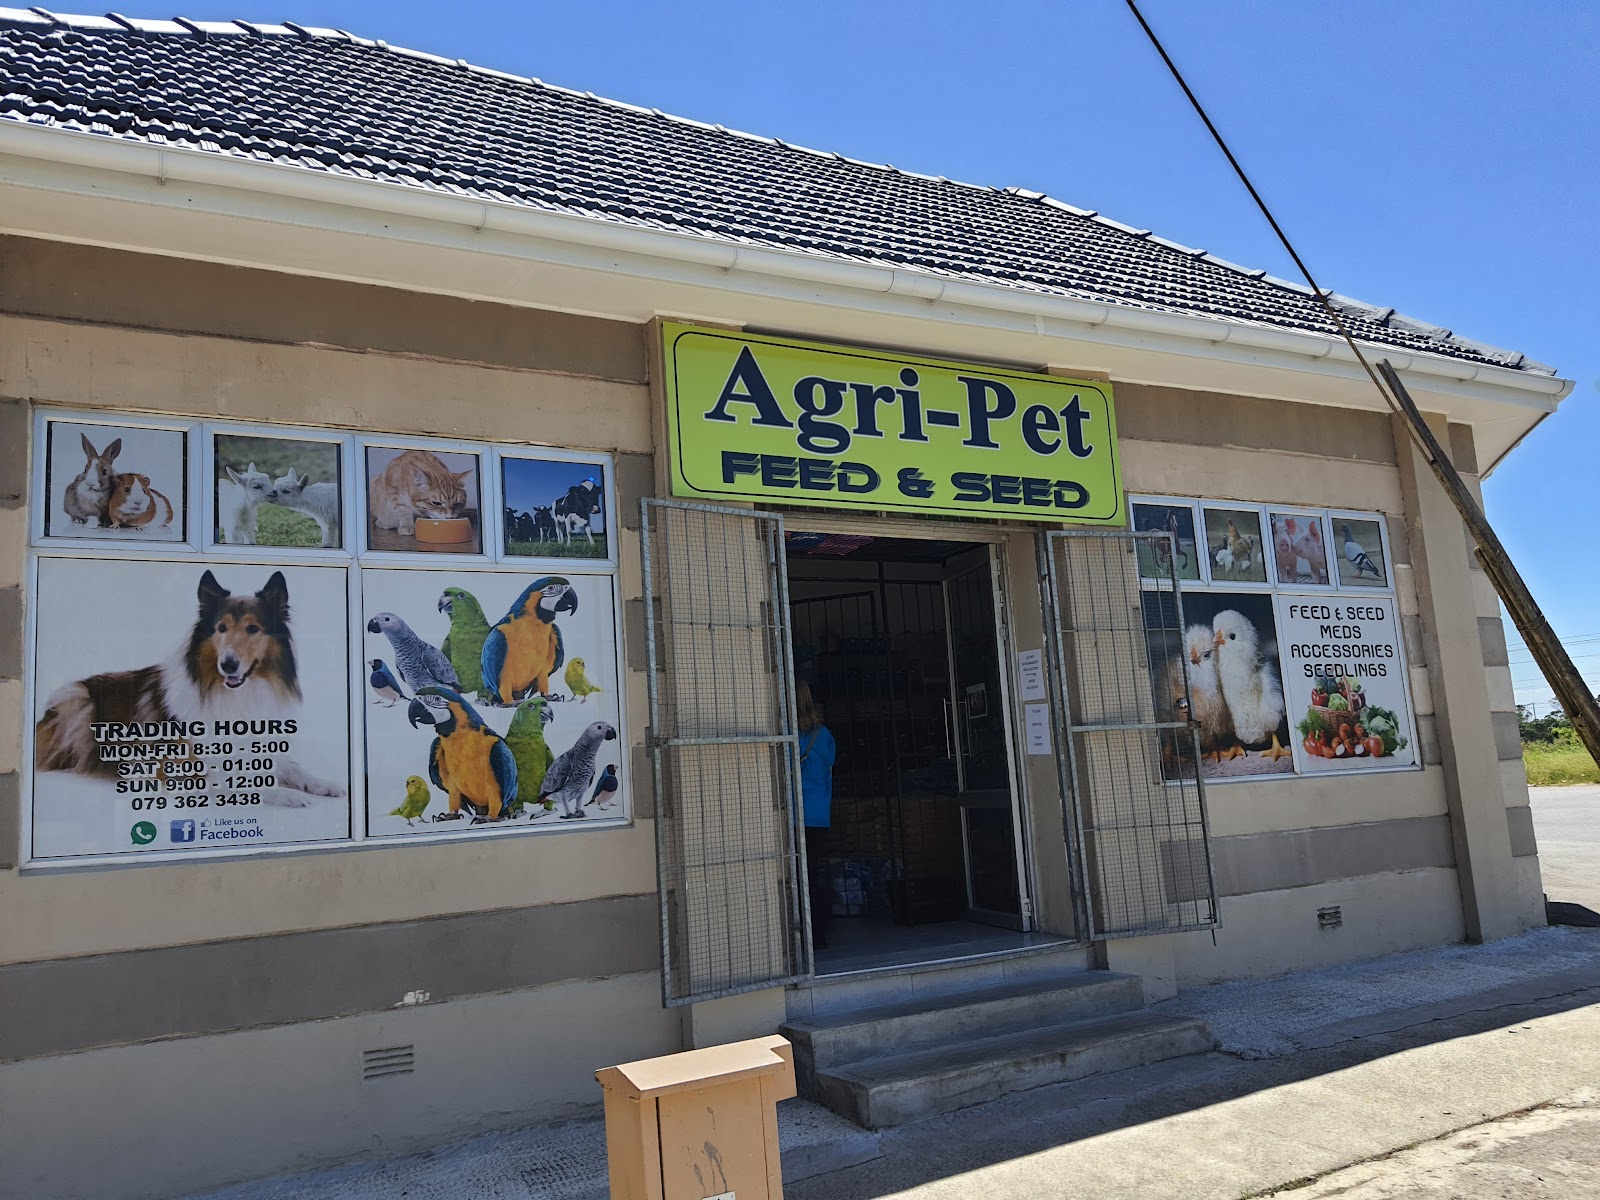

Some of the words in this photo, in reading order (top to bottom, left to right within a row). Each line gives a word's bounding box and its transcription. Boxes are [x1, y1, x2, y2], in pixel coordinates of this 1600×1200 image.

[703, 345, 1095, 460] Agri-Pet
[721, 450, 880, 494] FEED
[897, 467, 935, 499] &
[951, 472, 1090, 509] SEED
[1289, 605, 1331, 620] FEED
[1335, 607, 1344, 621] &
[1346, 606, 1385, 620] SEED
[1319, 625, 1362, 639] MEDS
[1290, 644, 1394, 659] ACCESSORIES
[1303, 663, 1387, 678] SEEDLINGS
[90, 720, 206, 741] TRADING
[213, 719, 298, 736] HOURS
[100, 743, 186, 760] MON-FRI
[192, 742, 233, 756] 8:30
[250, 740, 290, 754] 5:00
[118, 761, 158, 776] SAT
[163, 760, 205, 774] 8:00
[222, 758, 273, 772] 01:00
[116, 779, 159, 793] SUN
[165, 778, 207, 792] 9:00
[225, 775, 275, 789] 12:00
[131, 797, 168, 811] 079
[174, 795, 209, 809] 362
[215, 793, 261, 807] 3438
[214, 818, 232, 826] Like
[200, 826, 264, 841] Facebook
